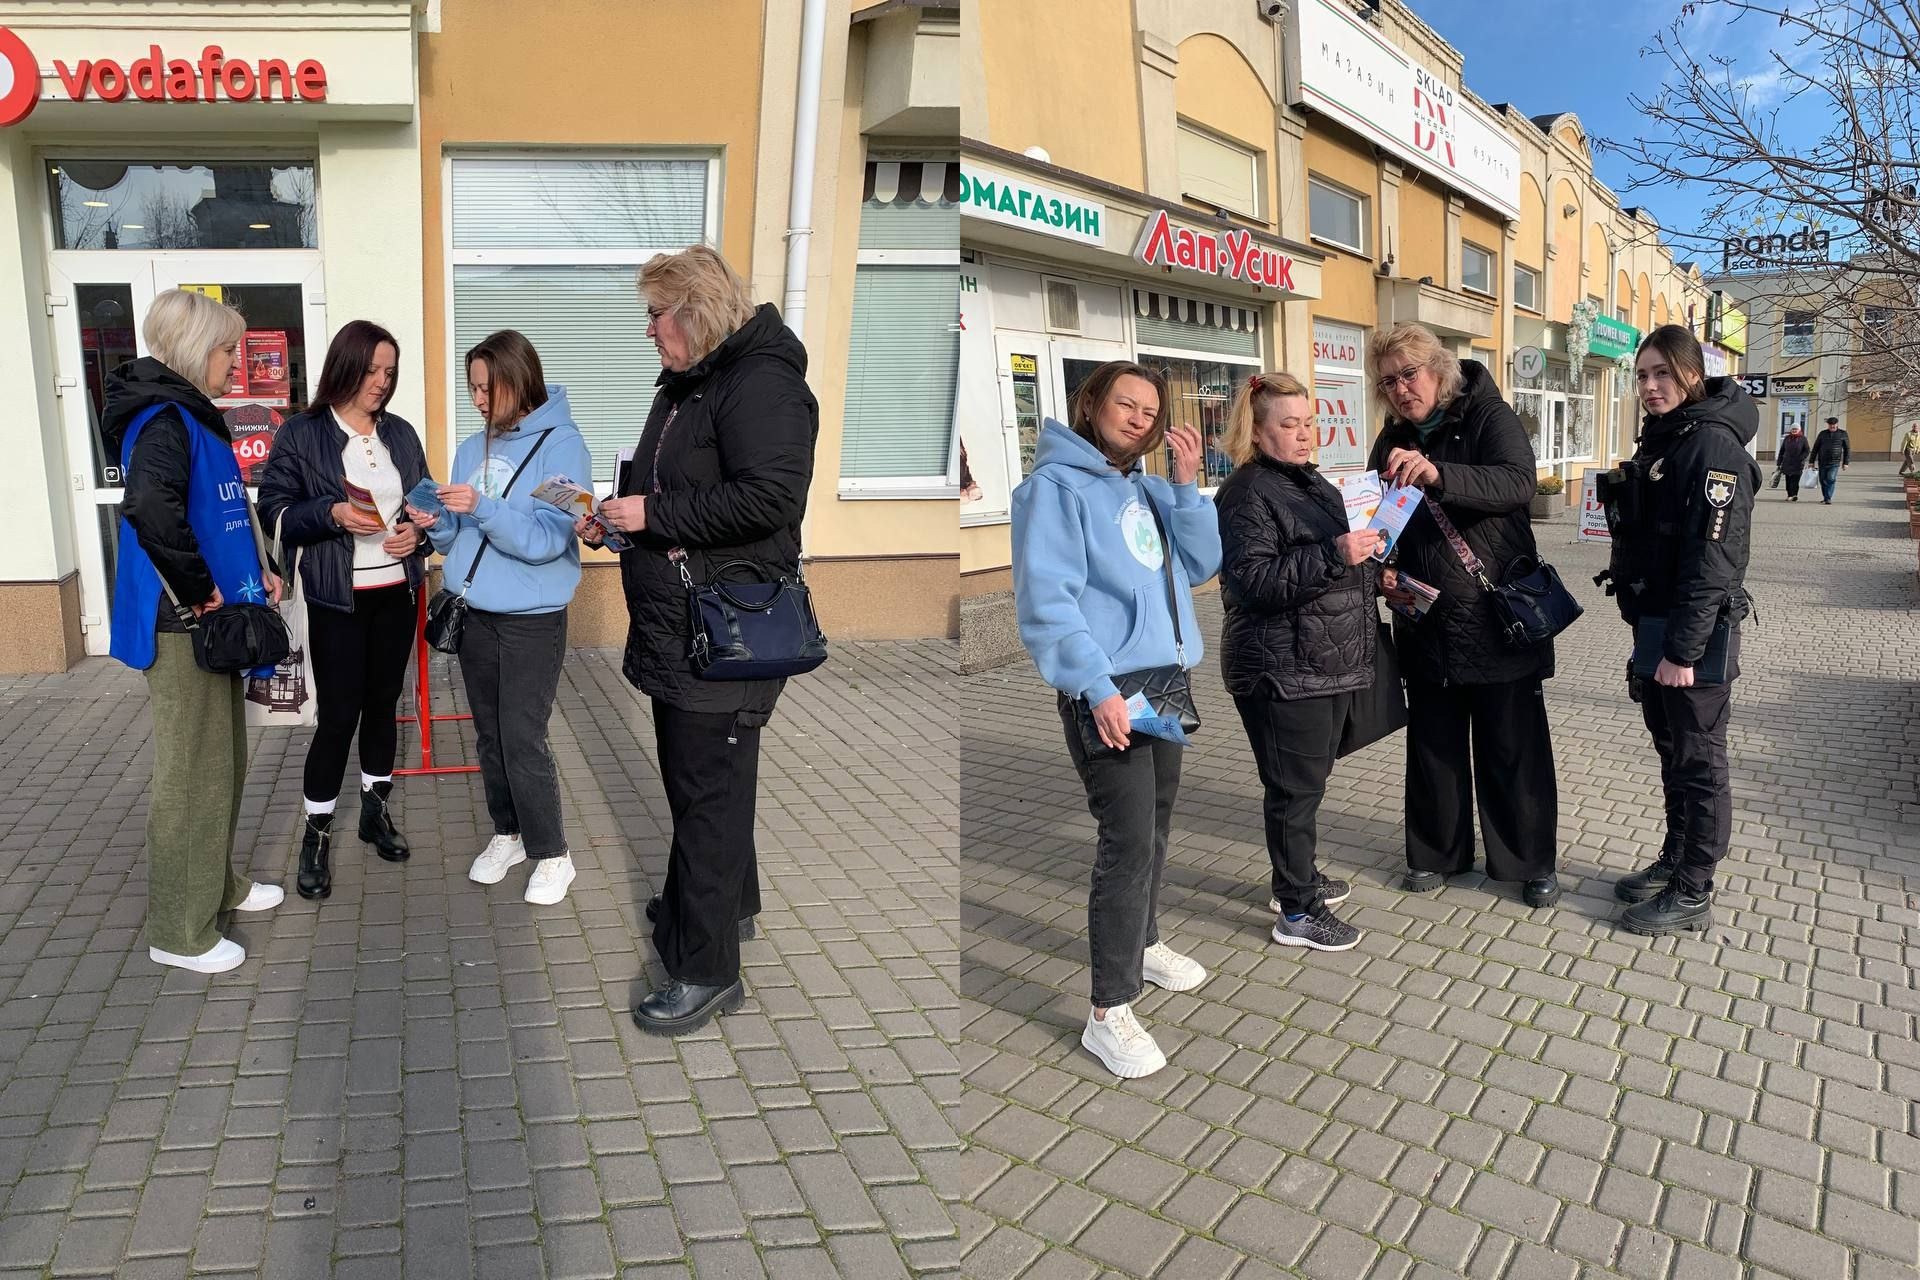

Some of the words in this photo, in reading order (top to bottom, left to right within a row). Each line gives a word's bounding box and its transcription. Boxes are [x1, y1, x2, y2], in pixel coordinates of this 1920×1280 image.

[53, 45, 328, 103] vodafone
[1417, 68, 1453, 107] SKLAD
[1723, 225, 1831, 270] panda
[1313, 341, 1355, 361] SKLAD
[268, 367, 283, 376] 200
[1522, 354, 1538, 371] FV
[225, 520, 243, 532] для
